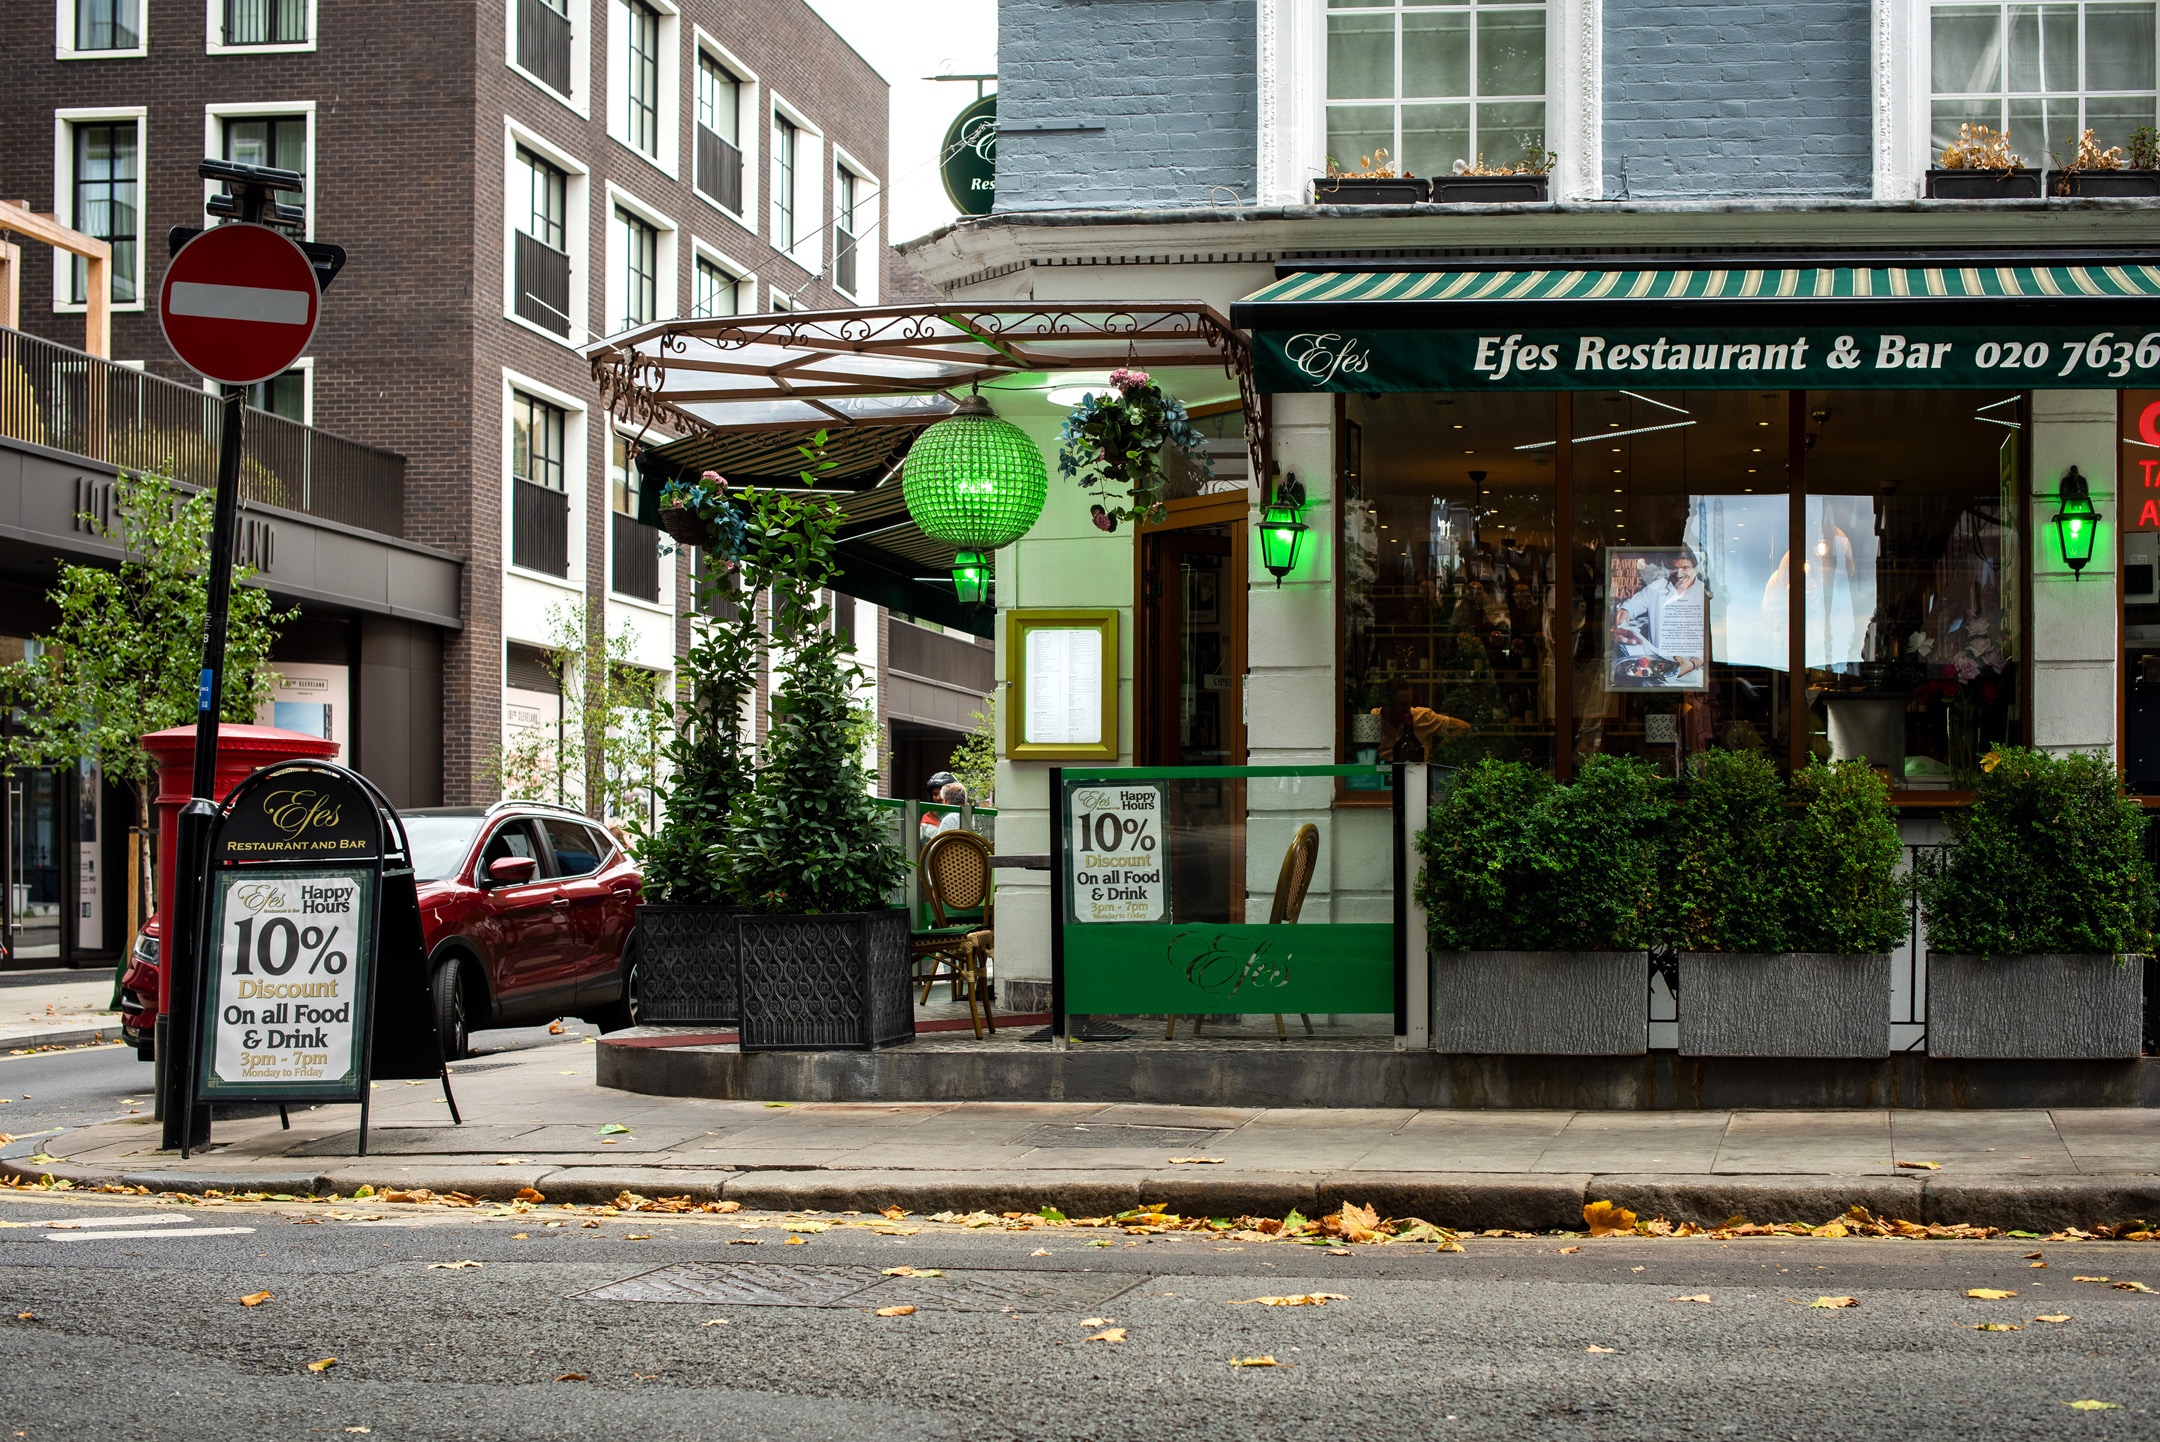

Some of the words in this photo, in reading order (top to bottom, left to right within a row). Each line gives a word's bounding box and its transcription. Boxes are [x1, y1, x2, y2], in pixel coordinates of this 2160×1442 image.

[1284, 333, 1370, 386] Efes
[1474, 334, 1559, 380] Efes
[1575, 336, 1809, 371] Restaurant
[1826, 335, 1861, 369] &
[1875, 335, 1952, 369] Bar
[1975, 342, 2049, 369] 020
[2058, 332, 2160, 377] 7636
[1611, 577, 1642, 587] MIDDLE
[1616, 587, 1636, 598] EAST
[1078, 790, 1111, 812] Efes
[1120, 791, 1156, 802] Happy
[1122, 801, 1154, 810] Hours
[263, 790, 342, 842] Efes
[1078, 812, 1156, 852] 10%
[1085, 854, 1151, 868] Discount
[1077, 872, 1098, 885] On
[1103, 870, 1120, 884] all
[1124, 869, 1160, 884] Food
[237, 884, 286, 916] Efes
[301, 886, 353, 902] Happy
[1092, 888, 1104, 901] &
[1108, 886, 1148, 900] Drink
[302, 900, 350, 914] Hours
[1091, 902, 1114, 914] 3pm
[1125, 902, 1148, 913] 7pm
[232, 917, 347, 976] 10%
[1168, 931, 1292, 1008] Efes
[238, 979, 339, 999] Discount
[224, 1005, 255, 1025] On
[262, 1002, 288, 1024] all
[295, 1002, 349, 1023] Food
[243, 1030, 262, 1049] &
[267, 1027, 328, 1049] Drink
[240, 1052, 276, 1069] 3pm
[293, 1051, 327, 1068] 7pm
[242, 1068, 280, 1078] Monday
[283, 1068, 292, 1076] to
[294, 1067, 323, 1078] Friday
